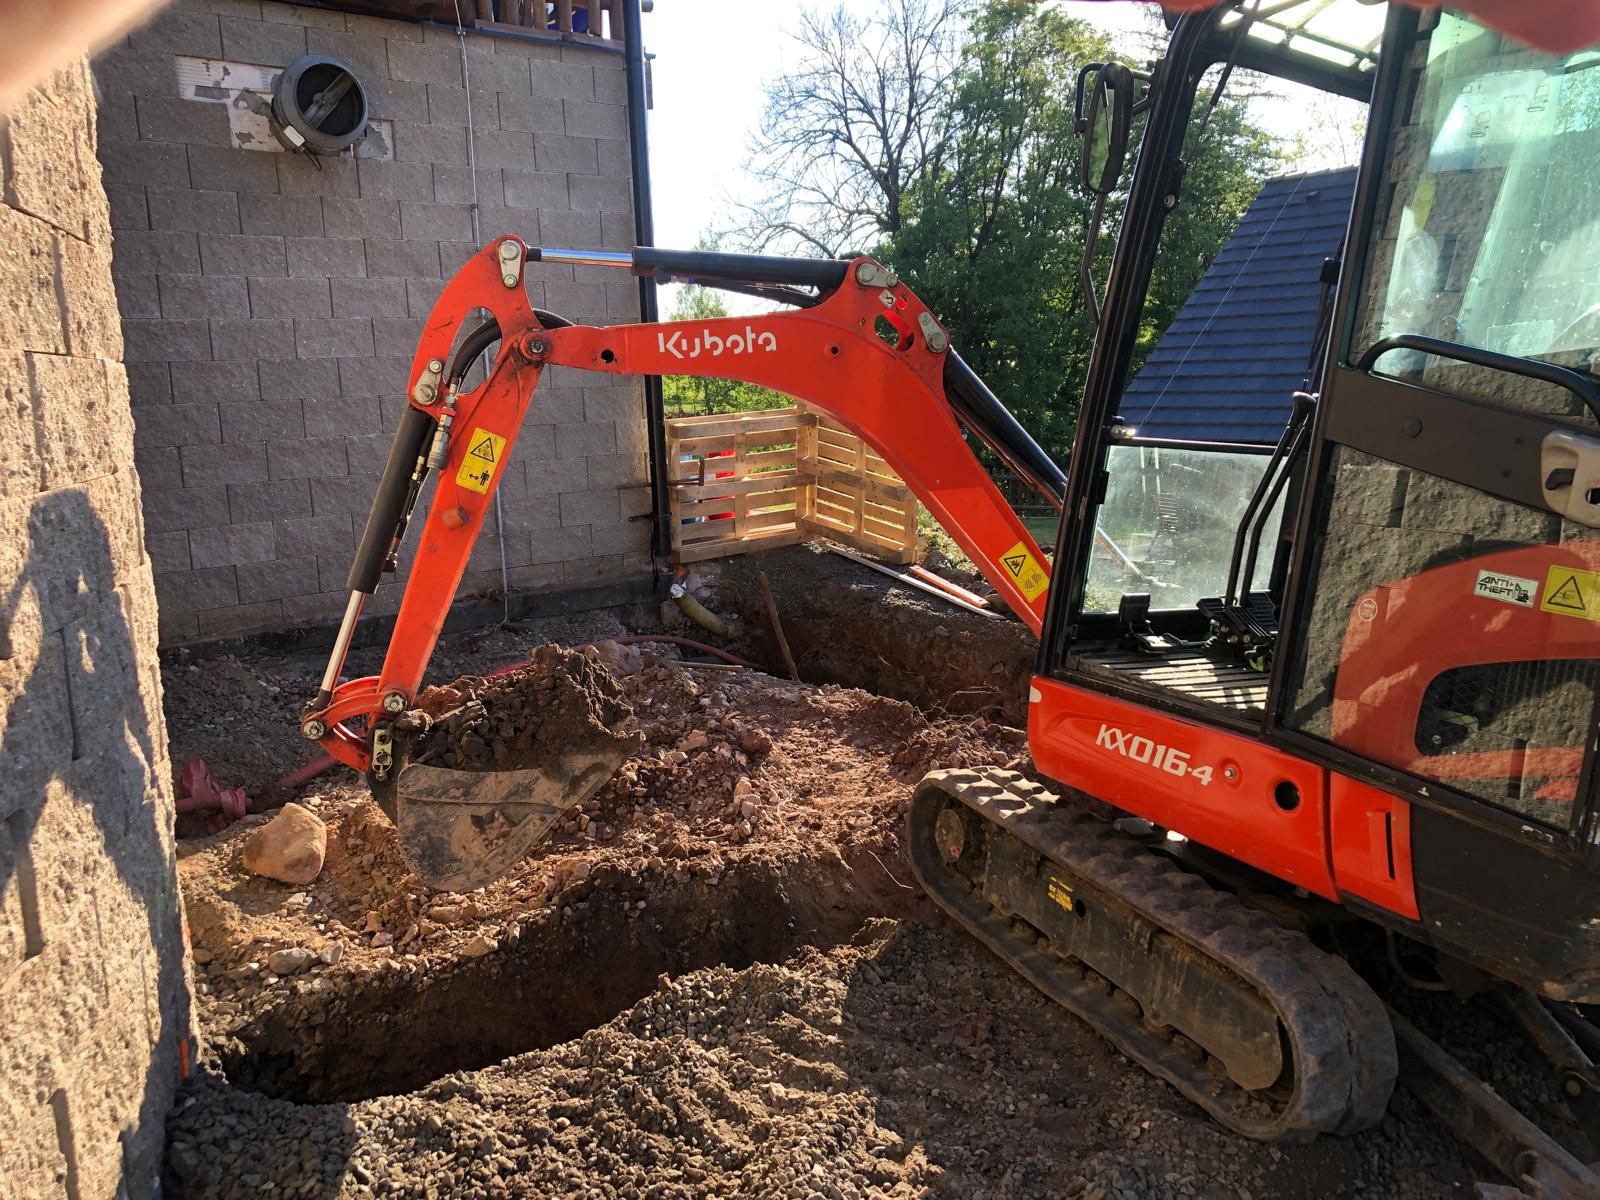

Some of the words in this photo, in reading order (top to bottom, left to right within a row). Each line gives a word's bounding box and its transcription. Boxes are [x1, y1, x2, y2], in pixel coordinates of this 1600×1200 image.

[657, 325, 777, 359] Kubota
[1480, 576, 1510, 587] ANTI
[1478, 583, 1514, 596] THEFT
